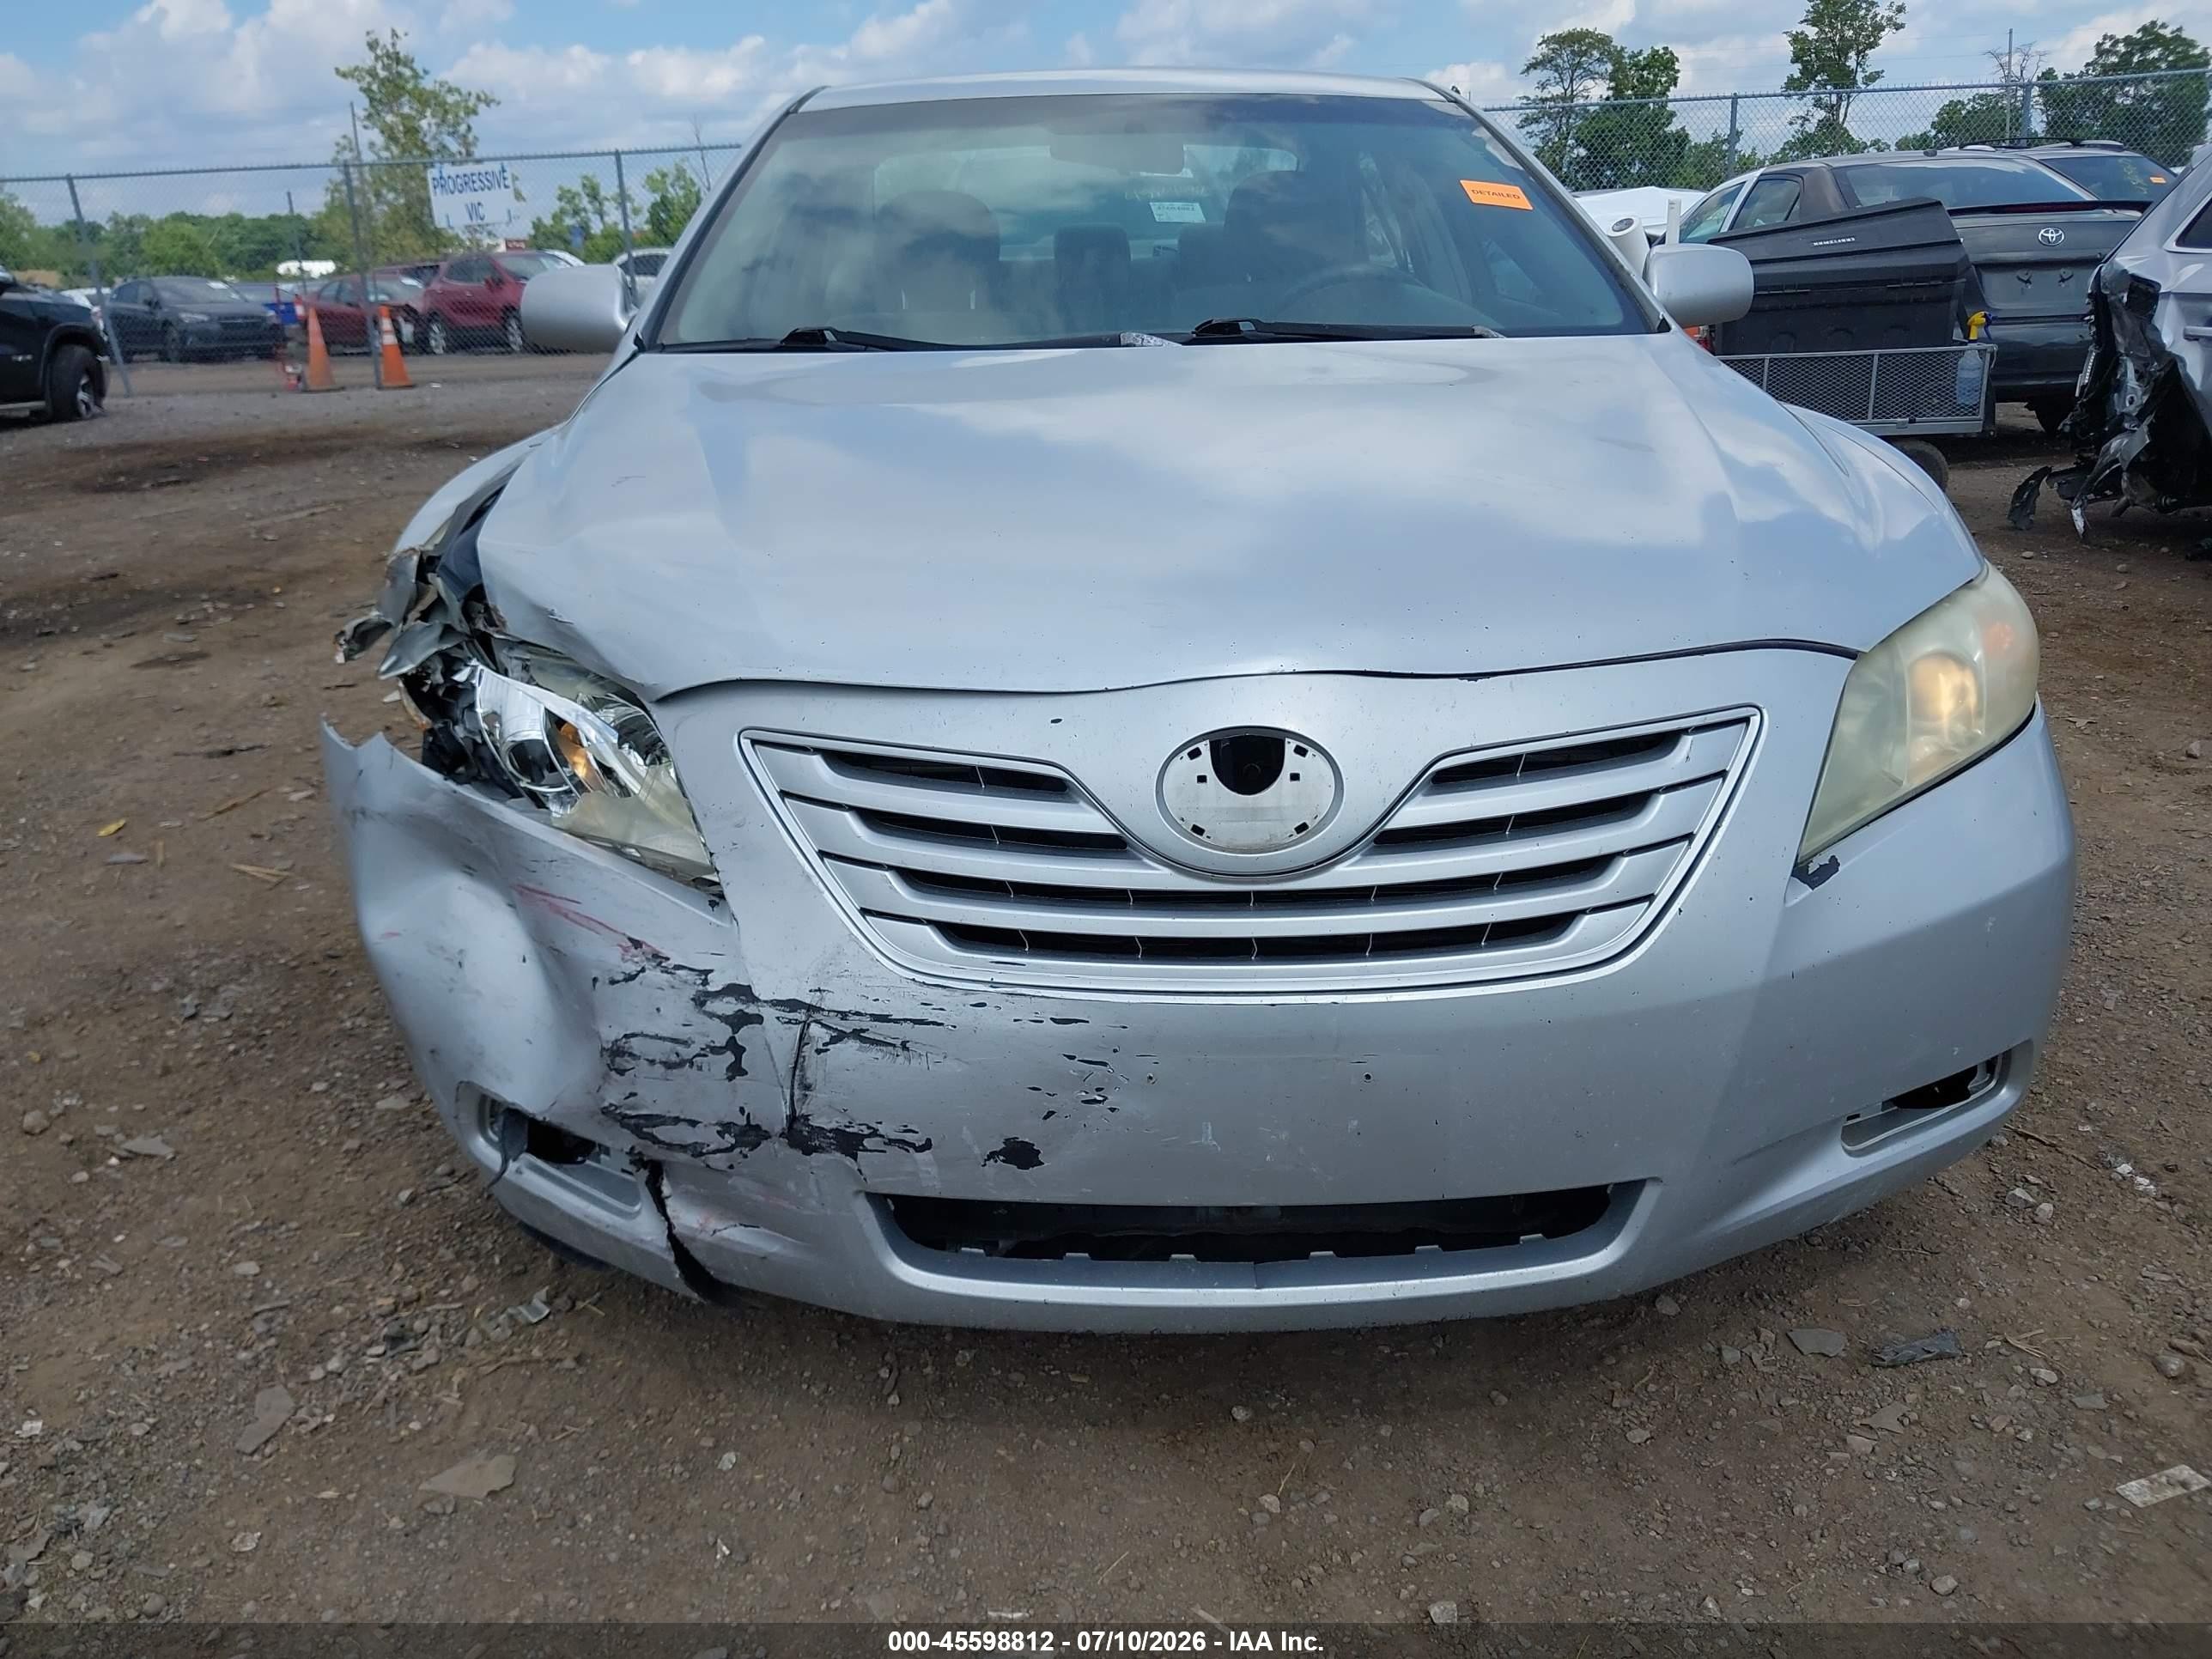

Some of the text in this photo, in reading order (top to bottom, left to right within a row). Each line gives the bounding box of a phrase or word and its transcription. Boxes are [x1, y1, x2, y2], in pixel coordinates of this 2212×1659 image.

[432, 170, 510, 196] PROGRESSIVE
[1471, 189, 1520, 199] DETAILED
[465, 202, 485, 222] VIC
